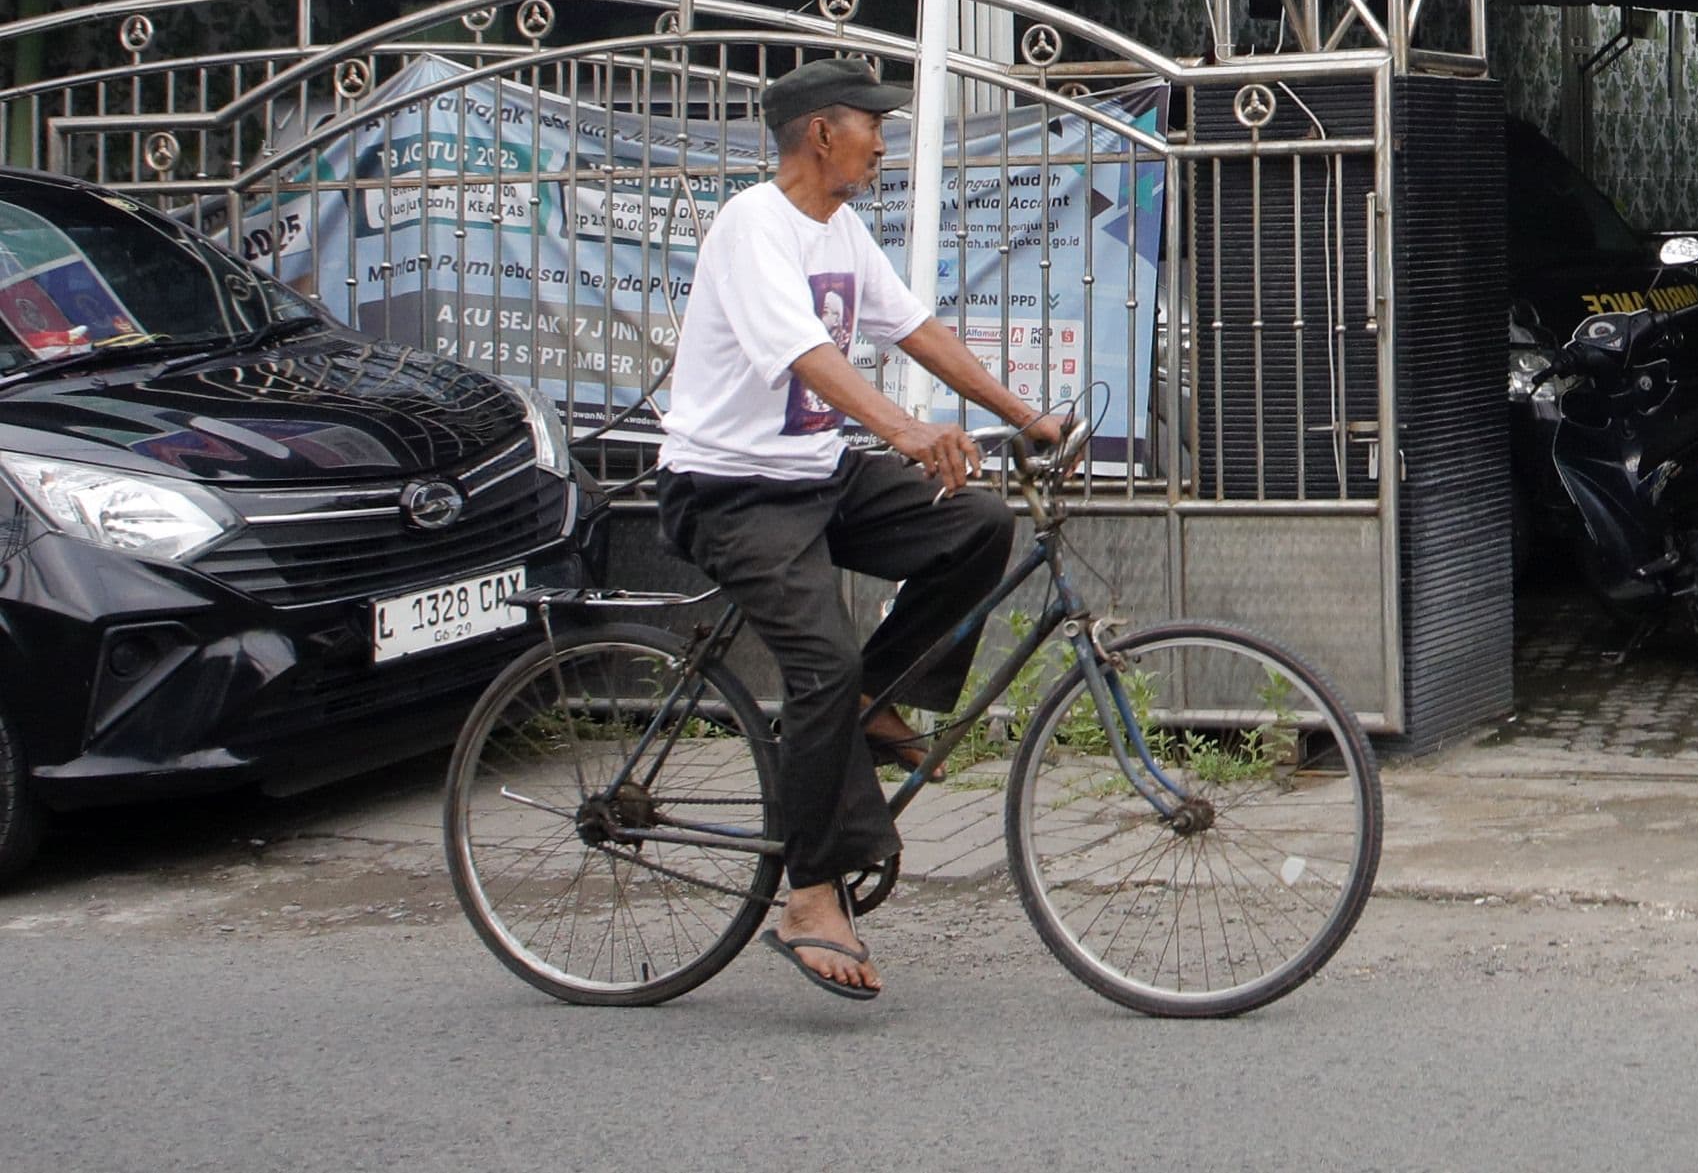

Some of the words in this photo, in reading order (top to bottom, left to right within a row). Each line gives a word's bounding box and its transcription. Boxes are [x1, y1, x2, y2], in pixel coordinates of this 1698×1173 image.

[500, 310, 560, 333] SEJAK
[480, 340, 509, 361] 26
[378, 607, 394, 640] L
[412, 586, 470, 631] 1328
